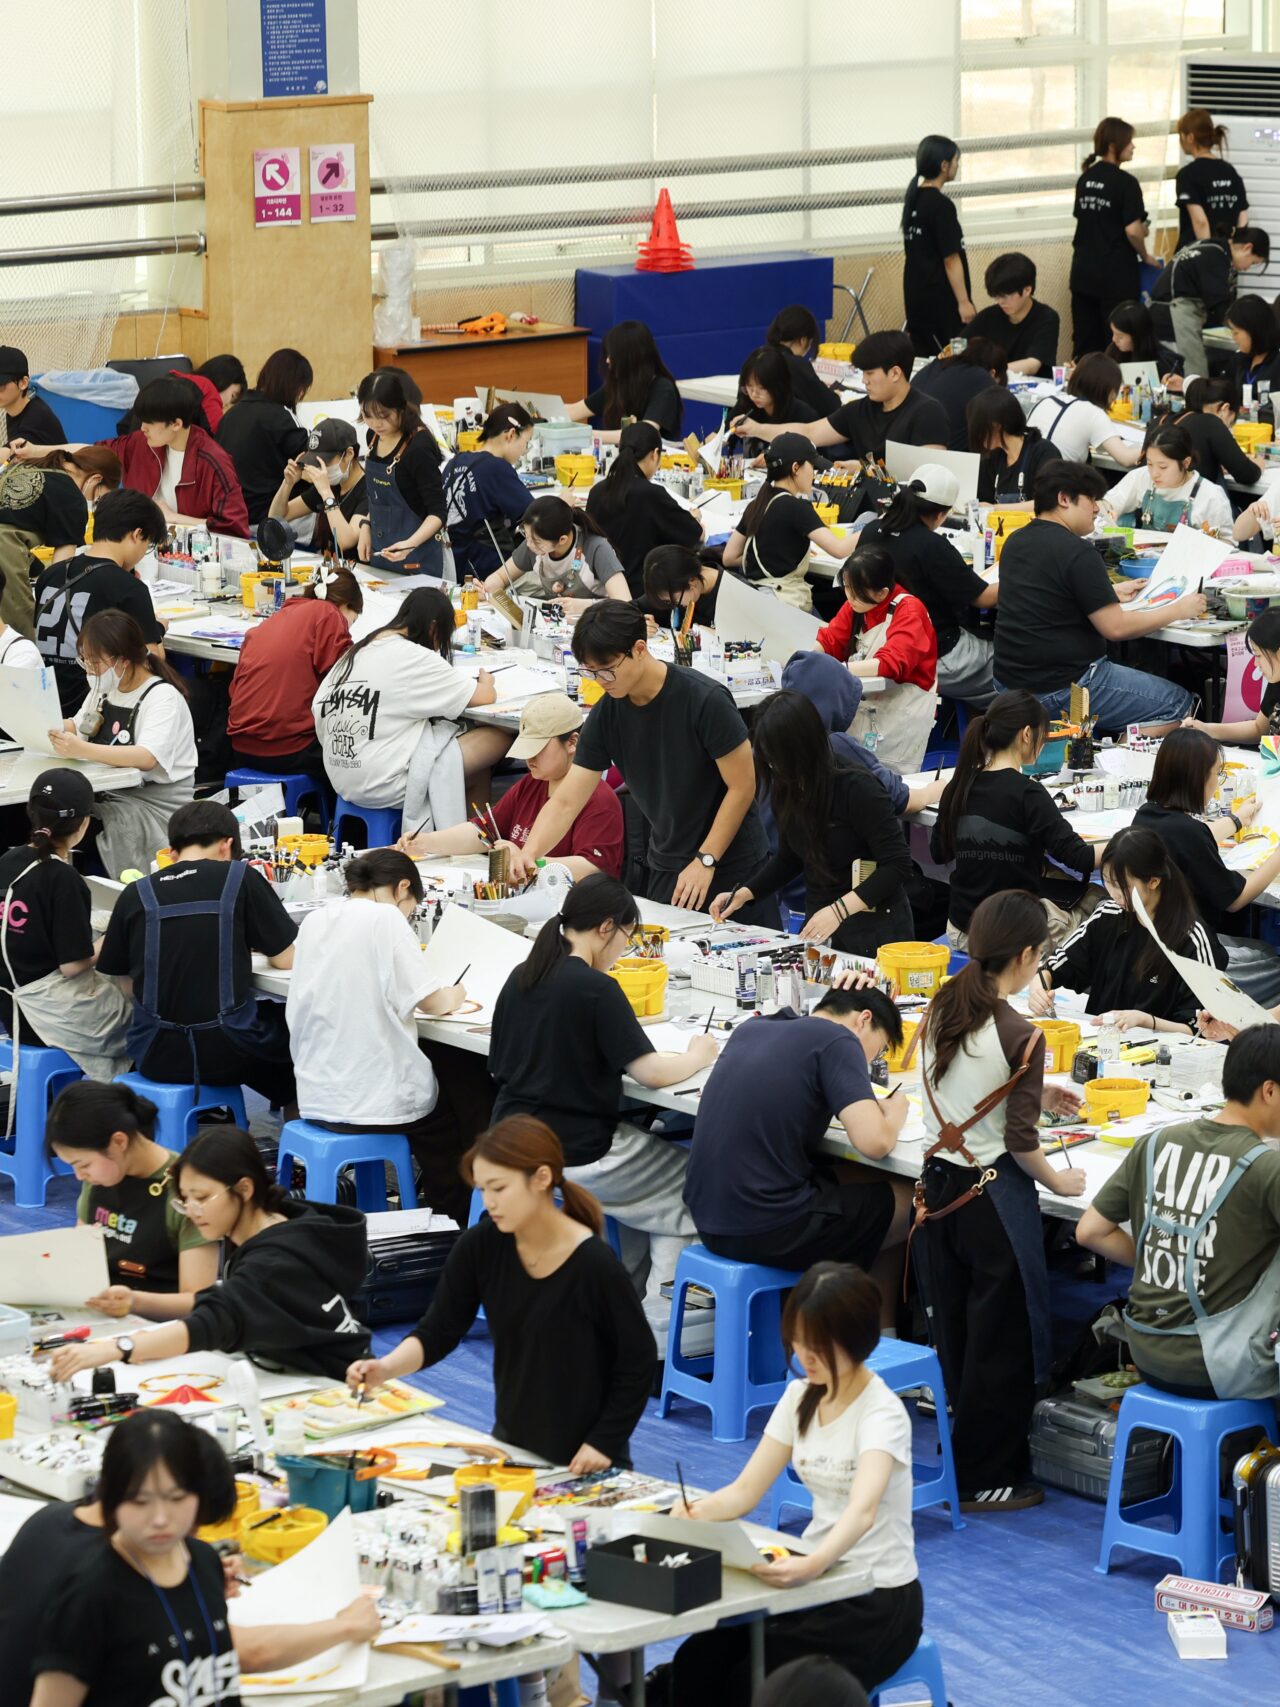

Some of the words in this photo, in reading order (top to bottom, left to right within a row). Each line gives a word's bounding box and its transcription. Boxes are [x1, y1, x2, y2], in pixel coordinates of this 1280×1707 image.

[261, 209, 266, 219] 1
[274, 207, 293, 218] 144
[332, 203, 345, 213] 32
[35, 586, 91, 659] 21
[1146, 1141, 1231, 1218] AIR
[94, 1206, 138, 1235] meta
[1140, 1243, 1209, 1296] SOLE
[1194, 1585, 1231, 1598] KITCHEN
